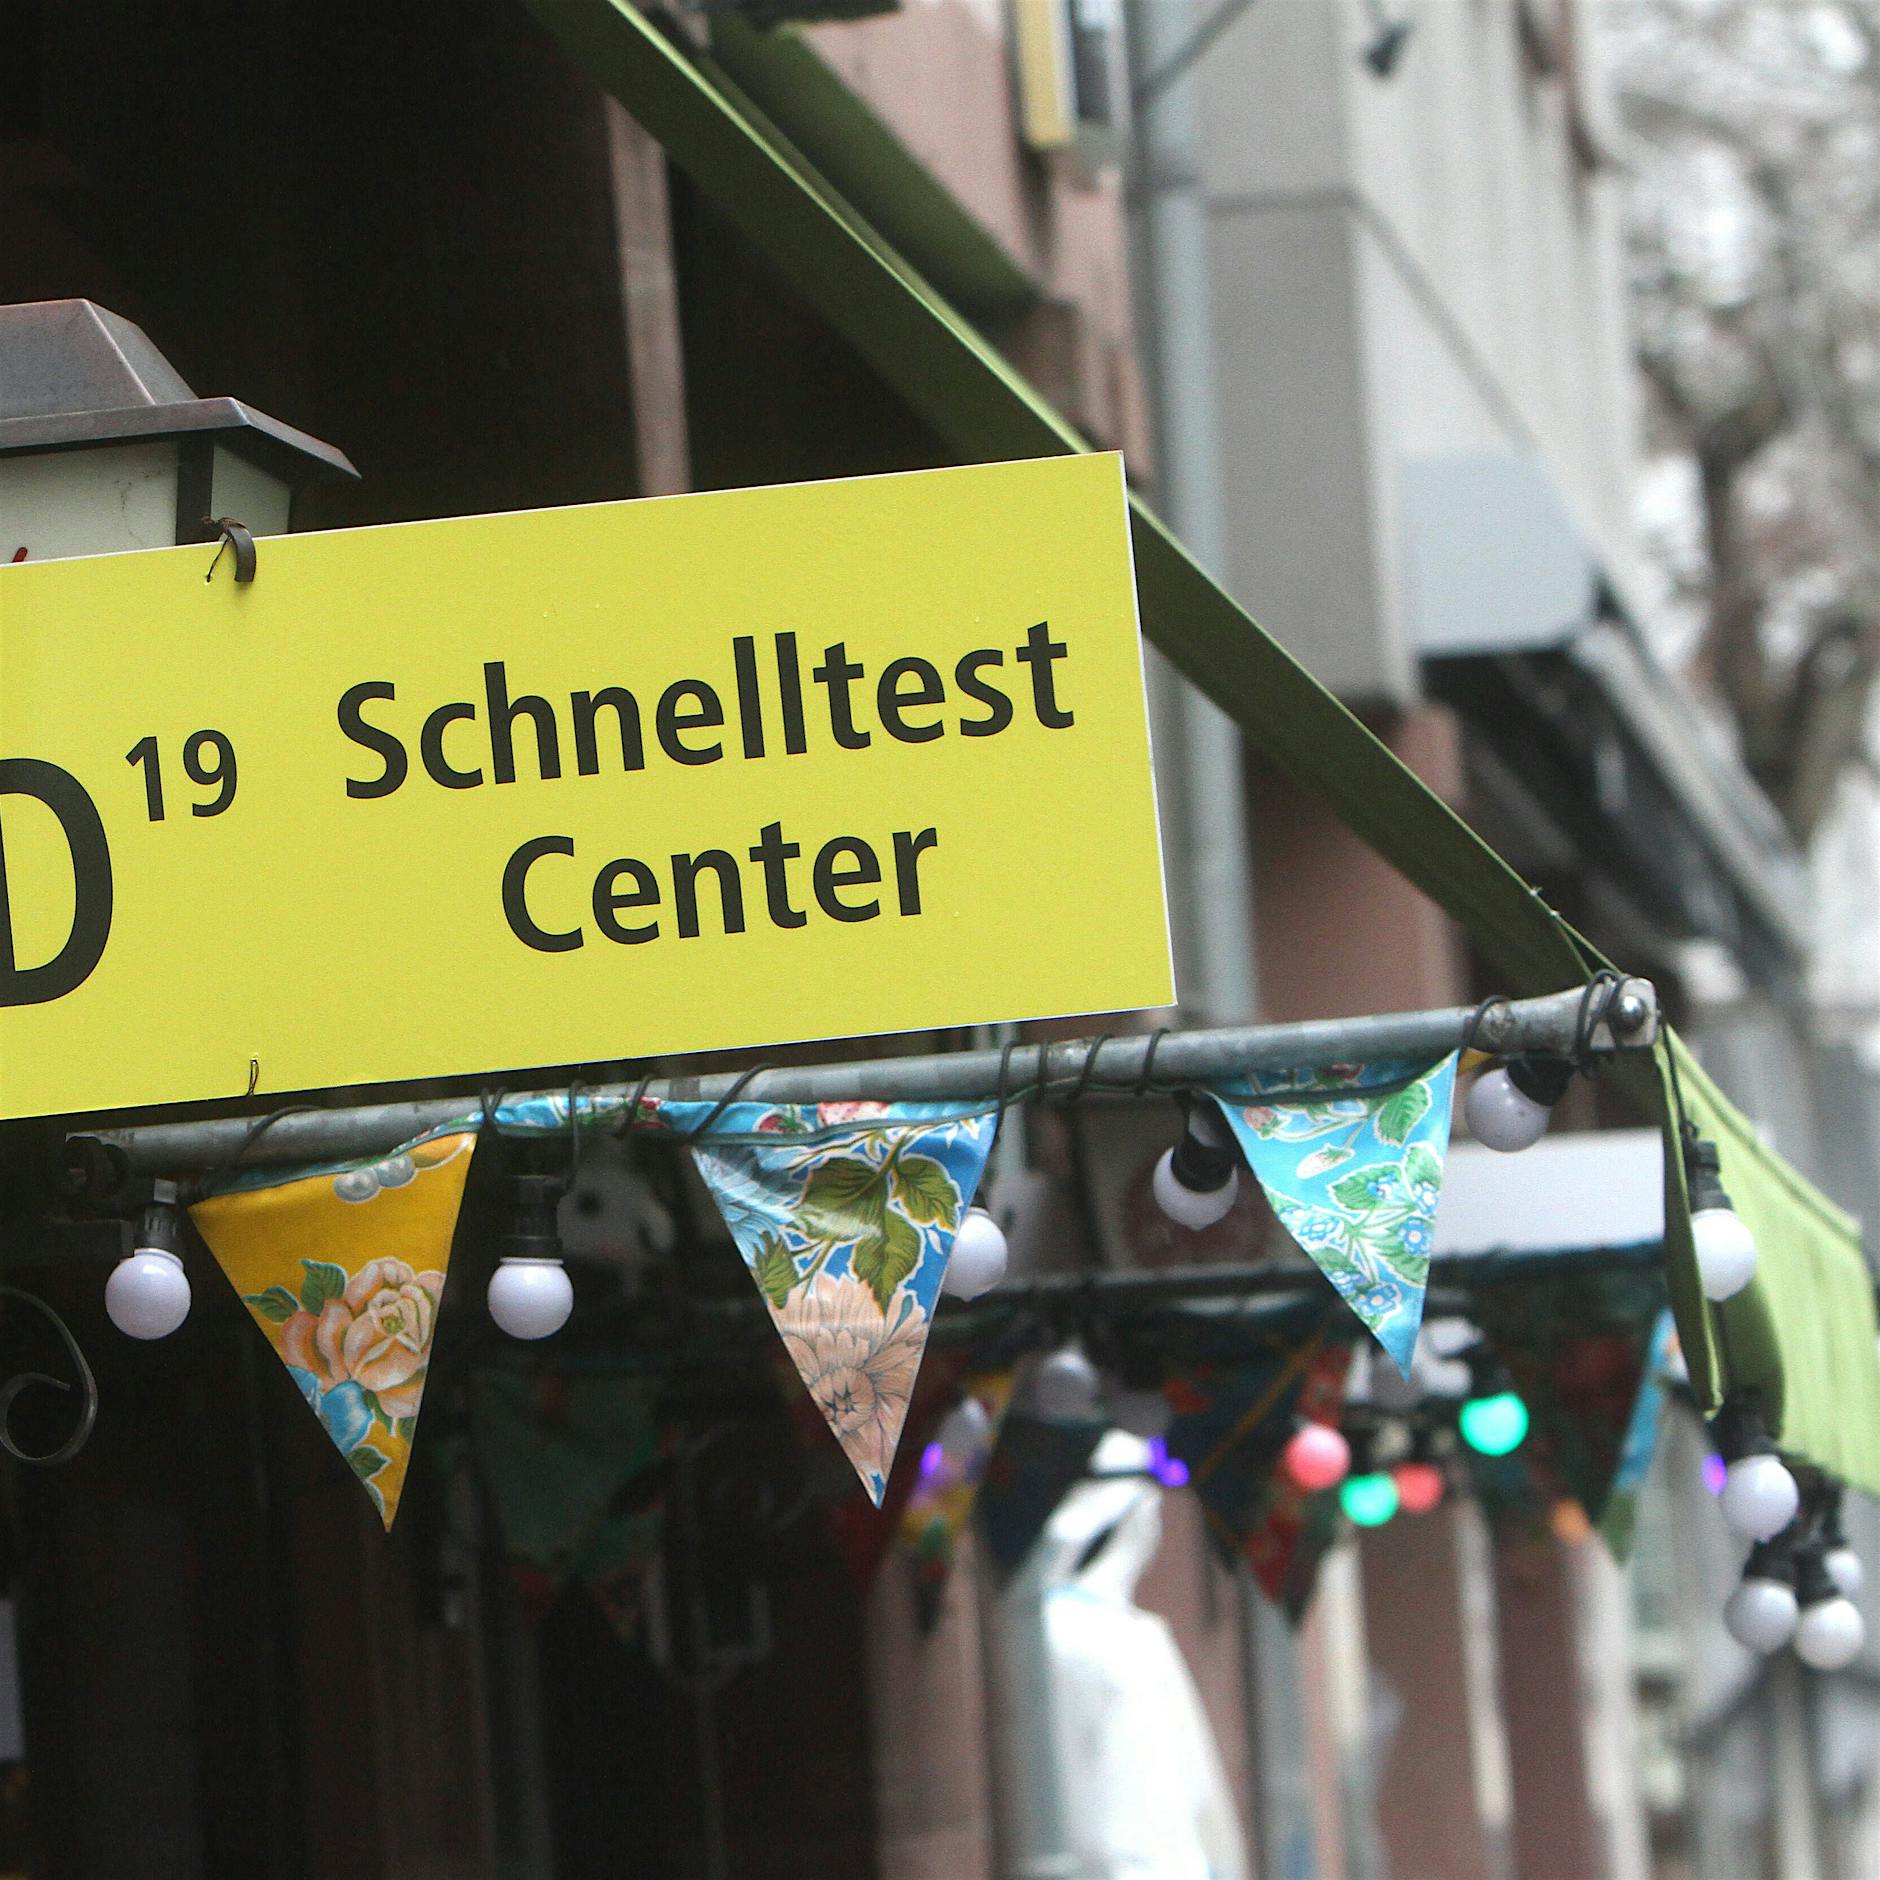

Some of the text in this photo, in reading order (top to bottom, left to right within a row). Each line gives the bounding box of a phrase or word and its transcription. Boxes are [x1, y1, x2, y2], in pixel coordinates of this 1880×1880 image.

[124, 729, 238, 823] 19
[337, 620, 1075, 800] Schnelltest
[501, 820, 938, 953] Center
